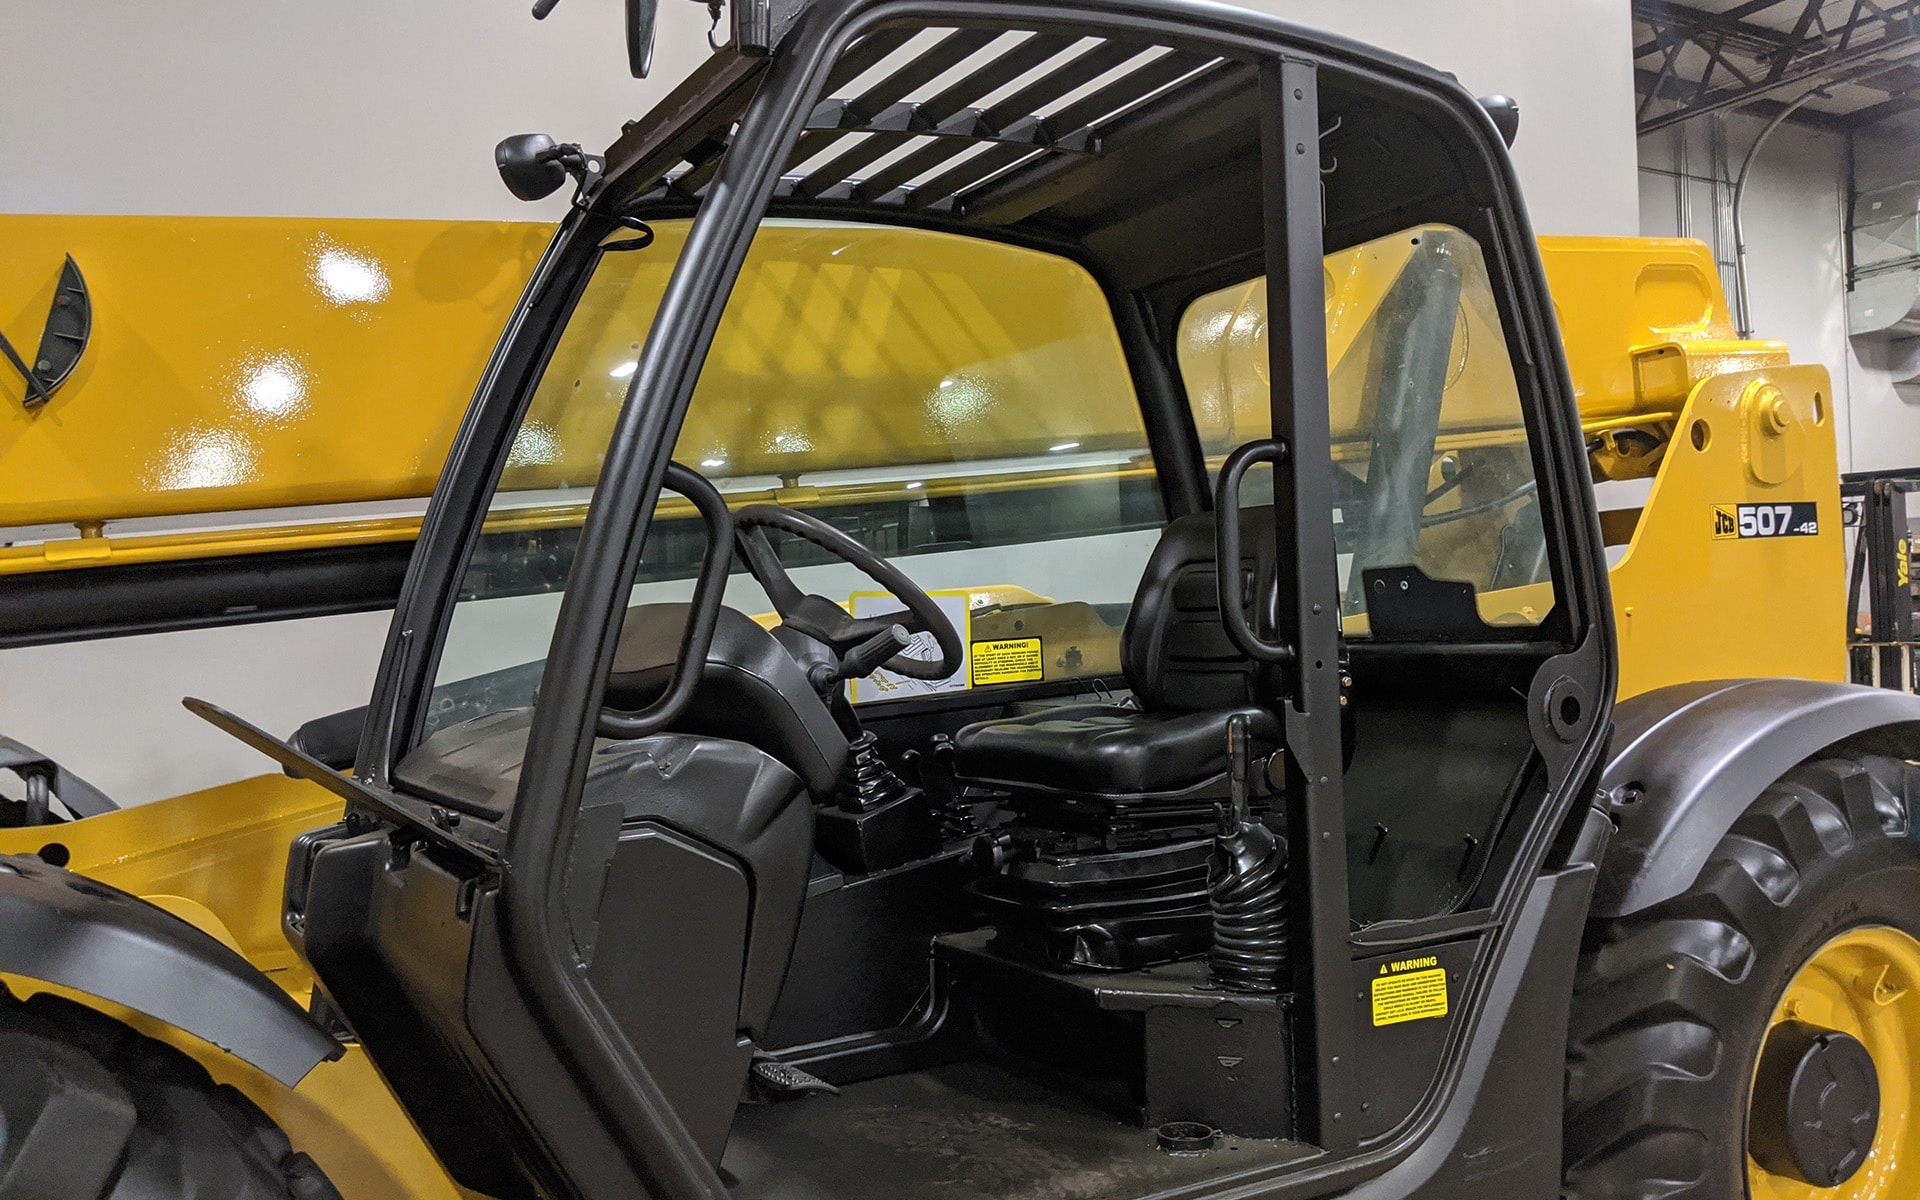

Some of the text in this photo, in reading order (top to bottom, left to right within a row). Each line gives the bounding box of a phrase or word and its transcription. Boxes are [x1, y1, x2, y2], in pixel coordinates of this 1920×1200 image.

[1715, 509, 1735, 535] JCB
[1738, 505, 1793, 536] 507
[1896, 538, 1909, 588] Yale
[992, 641, 1029, 651] WARNING!
[1390, 956, 1438, 973] WARNING
